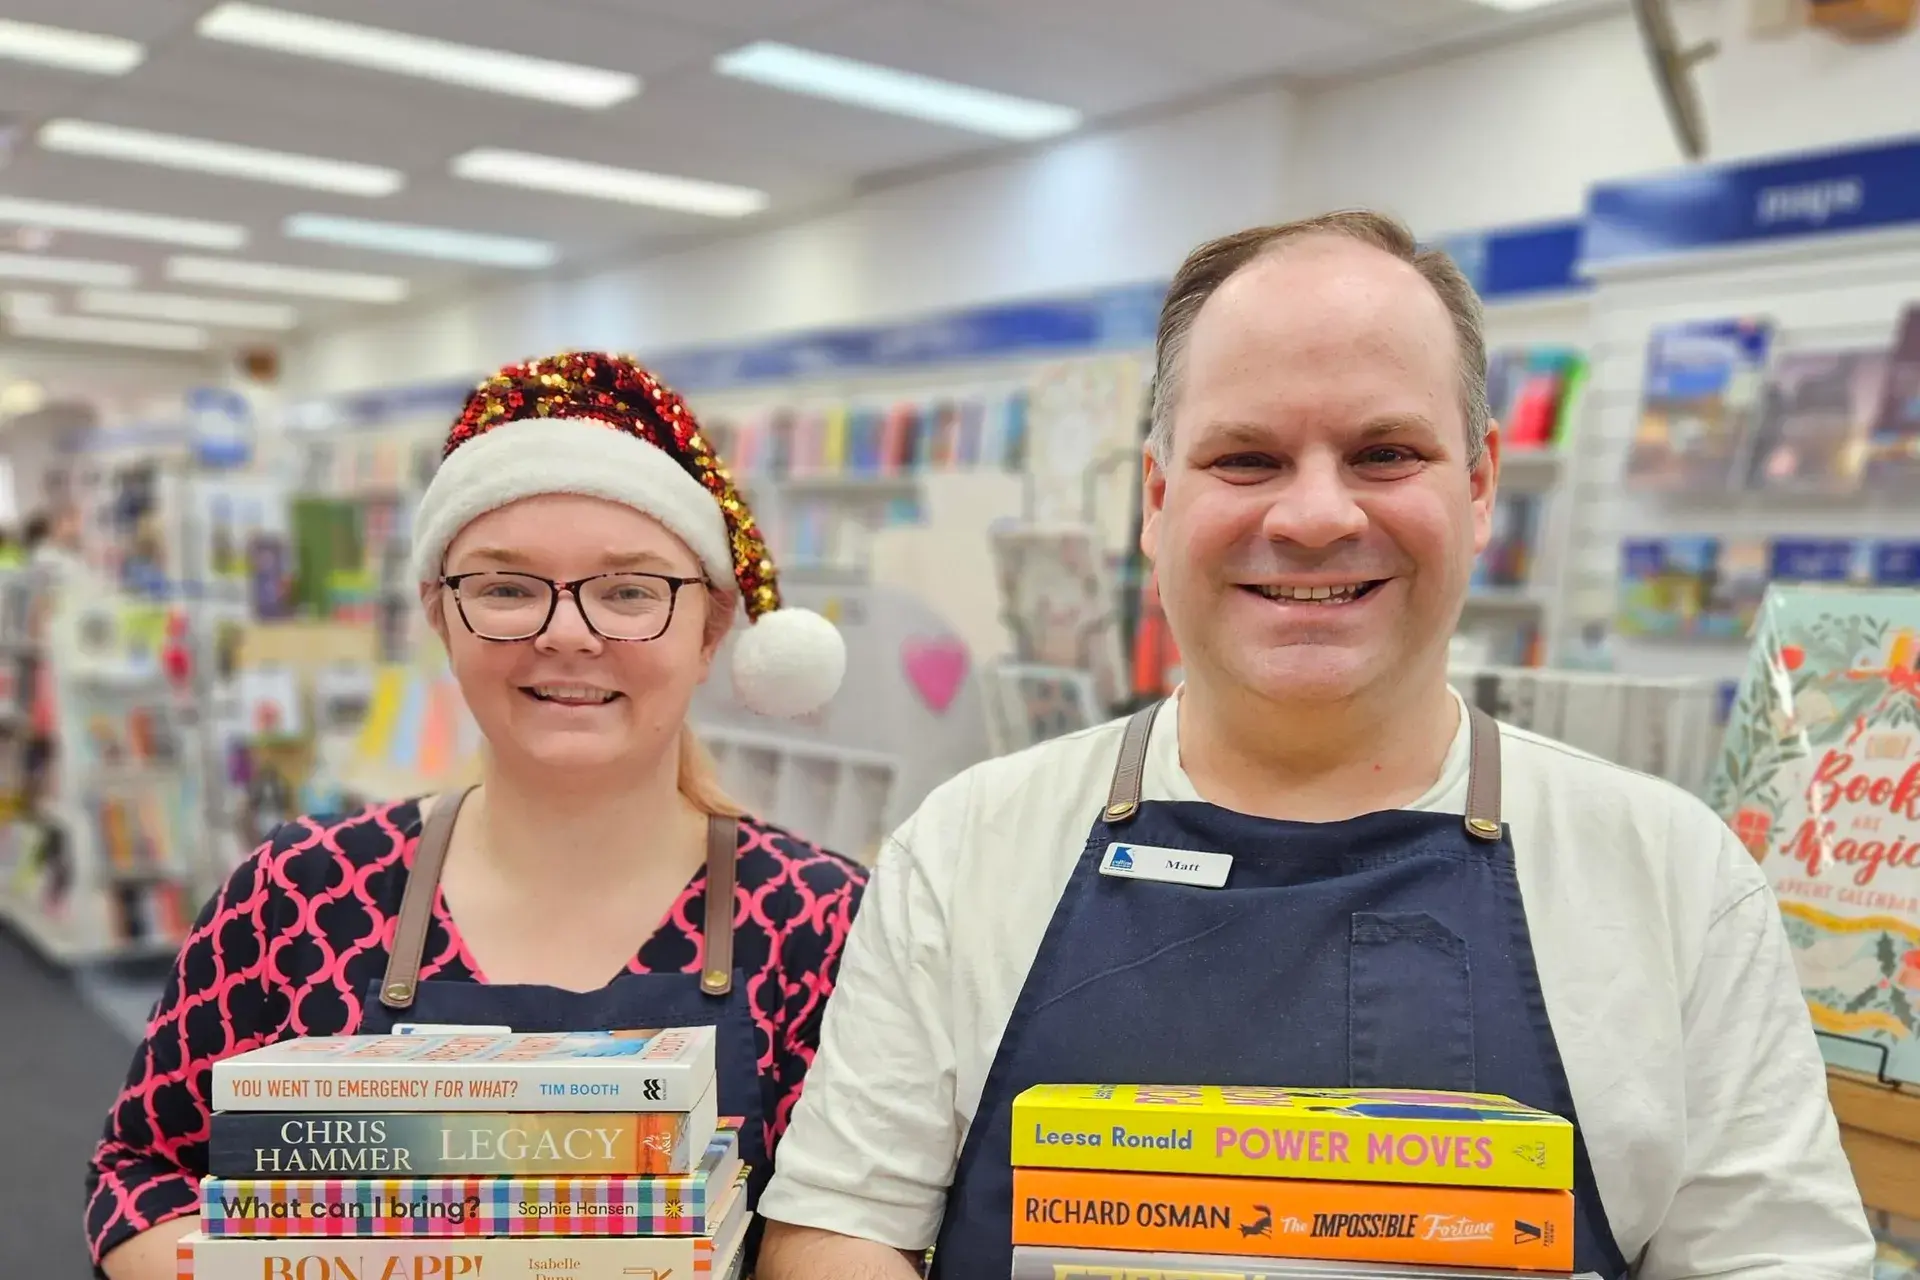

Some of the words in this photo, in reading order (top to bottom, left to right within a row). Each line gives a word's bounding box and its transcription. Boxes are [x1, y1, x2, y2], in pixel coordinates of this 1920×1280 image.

[1165, 860, 1201, 872] Matt
[232, 1079, 262, 1098] YOU
[267, 1079, 310, 1098] WENT
[314, 1079, 332, 1098] TO
[338, 1079, 429, 1098] EMERGENCY
[434, 1079, 464, 1098] FOR
[469, 1079, 518, 1098] WHAT?
[539, 1083, 565, 1096] TIM
[570, 1083, 620, 1096] BOOTH
[280, 1120, 387, 1144] CHRIS
[438, 1128, 624, 1161] LEGACY
[1035, 1123, 1101, 1147] Leesa
[1111, 1126, 1193, 1151] Ronald
[254, 1146, 413, 1172] HAMMER
[1215, 1126, 1350, 1164] POWER
[1366, 1133, 1494, 1170] MOVES
[220, 1195, 301, 1219] What
[310, 1202, 364, 1219] can
[375, 1196, 381, 1219] I
[390, 1195, 481, 1225] bring?
[518, 1201, 571, 1219] Sophie
[576, 1201, 634, 1216] Hansen
[1136, 1203, 1231, 1230] OSMAN
[1281, 1215, 1308, 1234] The
[1310, 1213, 1419, 1239] IMPOSS!BLE
[1420, 1213, 1495, 1242] Fortune
[264, 1256, 364, 1280] BON
[380, 1255, 484, 1280] APP!
[528, 1257, 581, 1270] Isabelle
